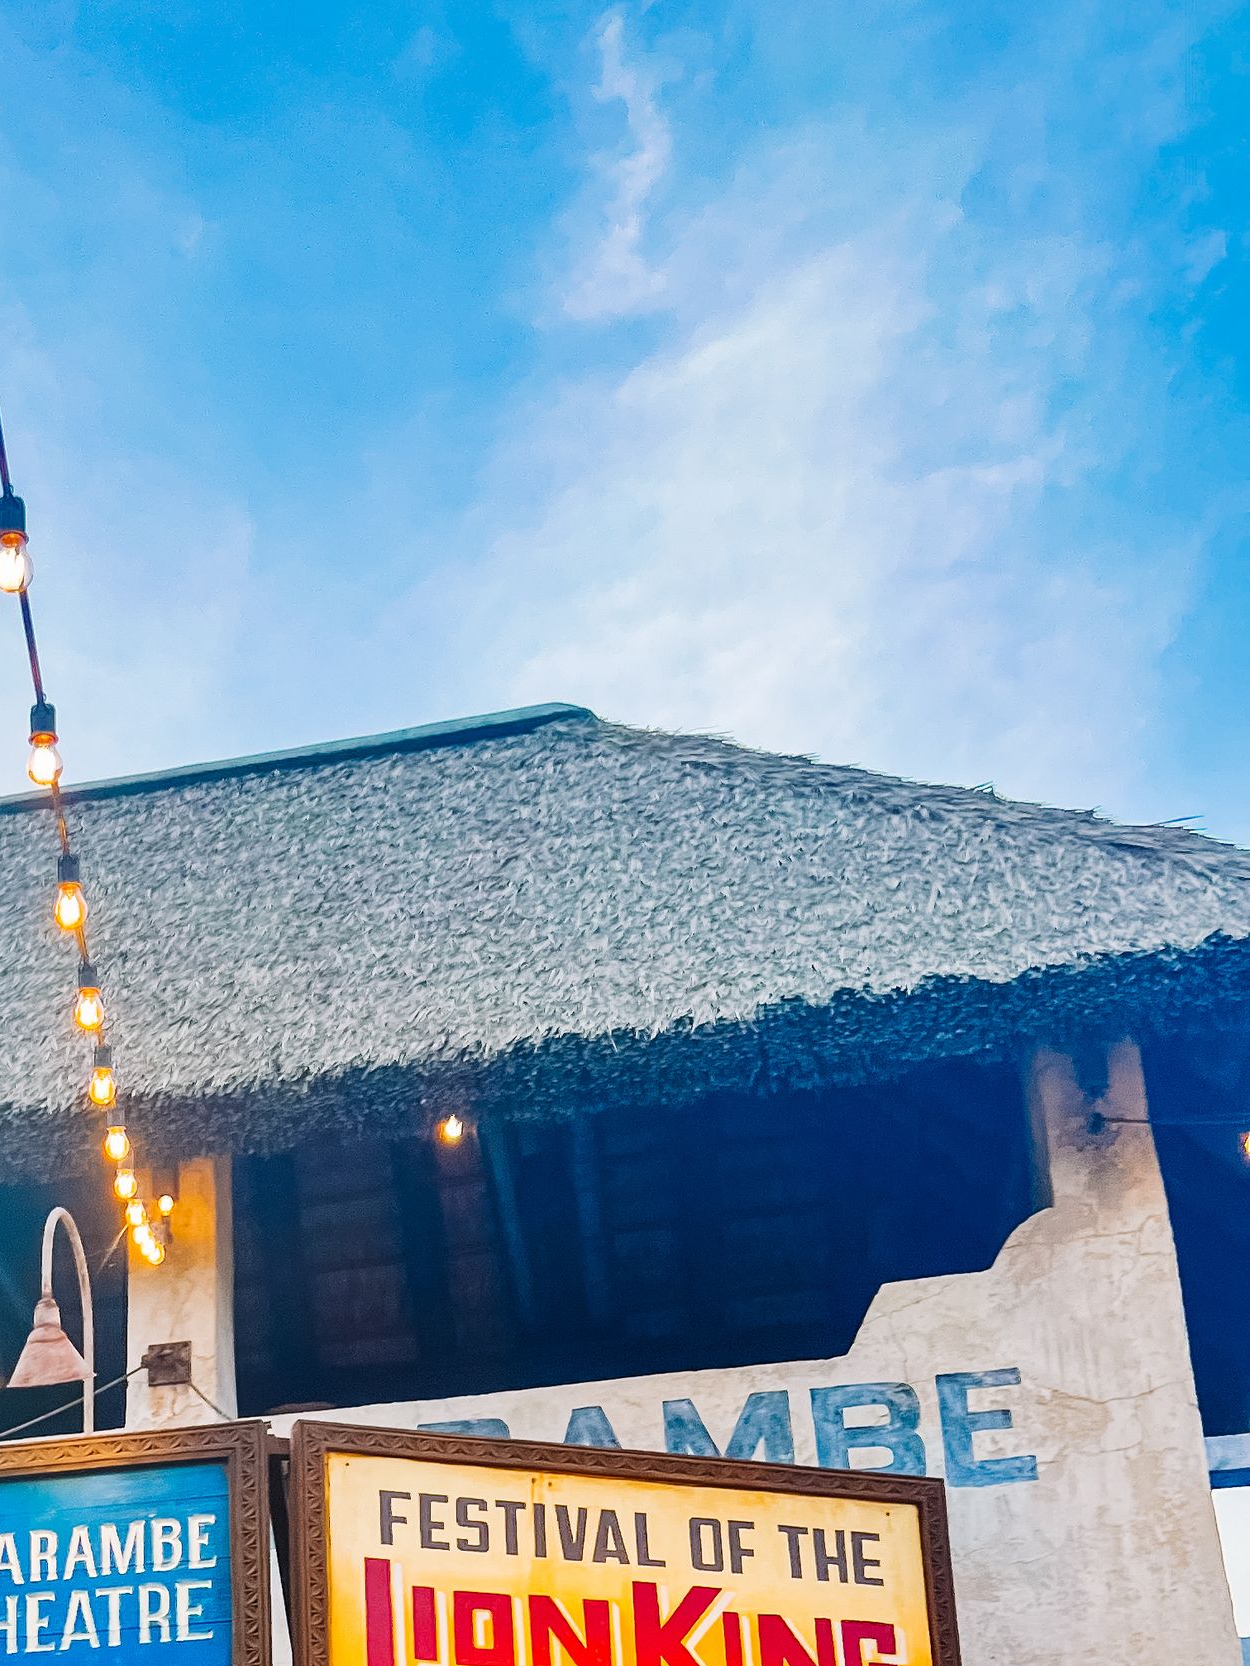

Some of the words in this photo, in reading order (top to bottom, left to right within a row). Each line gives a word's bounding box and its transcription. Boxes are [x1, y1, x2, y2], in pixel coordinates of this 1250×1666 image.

[378, 1490, 666, 1568] FESTIVAL
[689, 1516, 755, 1574] OF
[778, 1525, 885, 1587] THE
